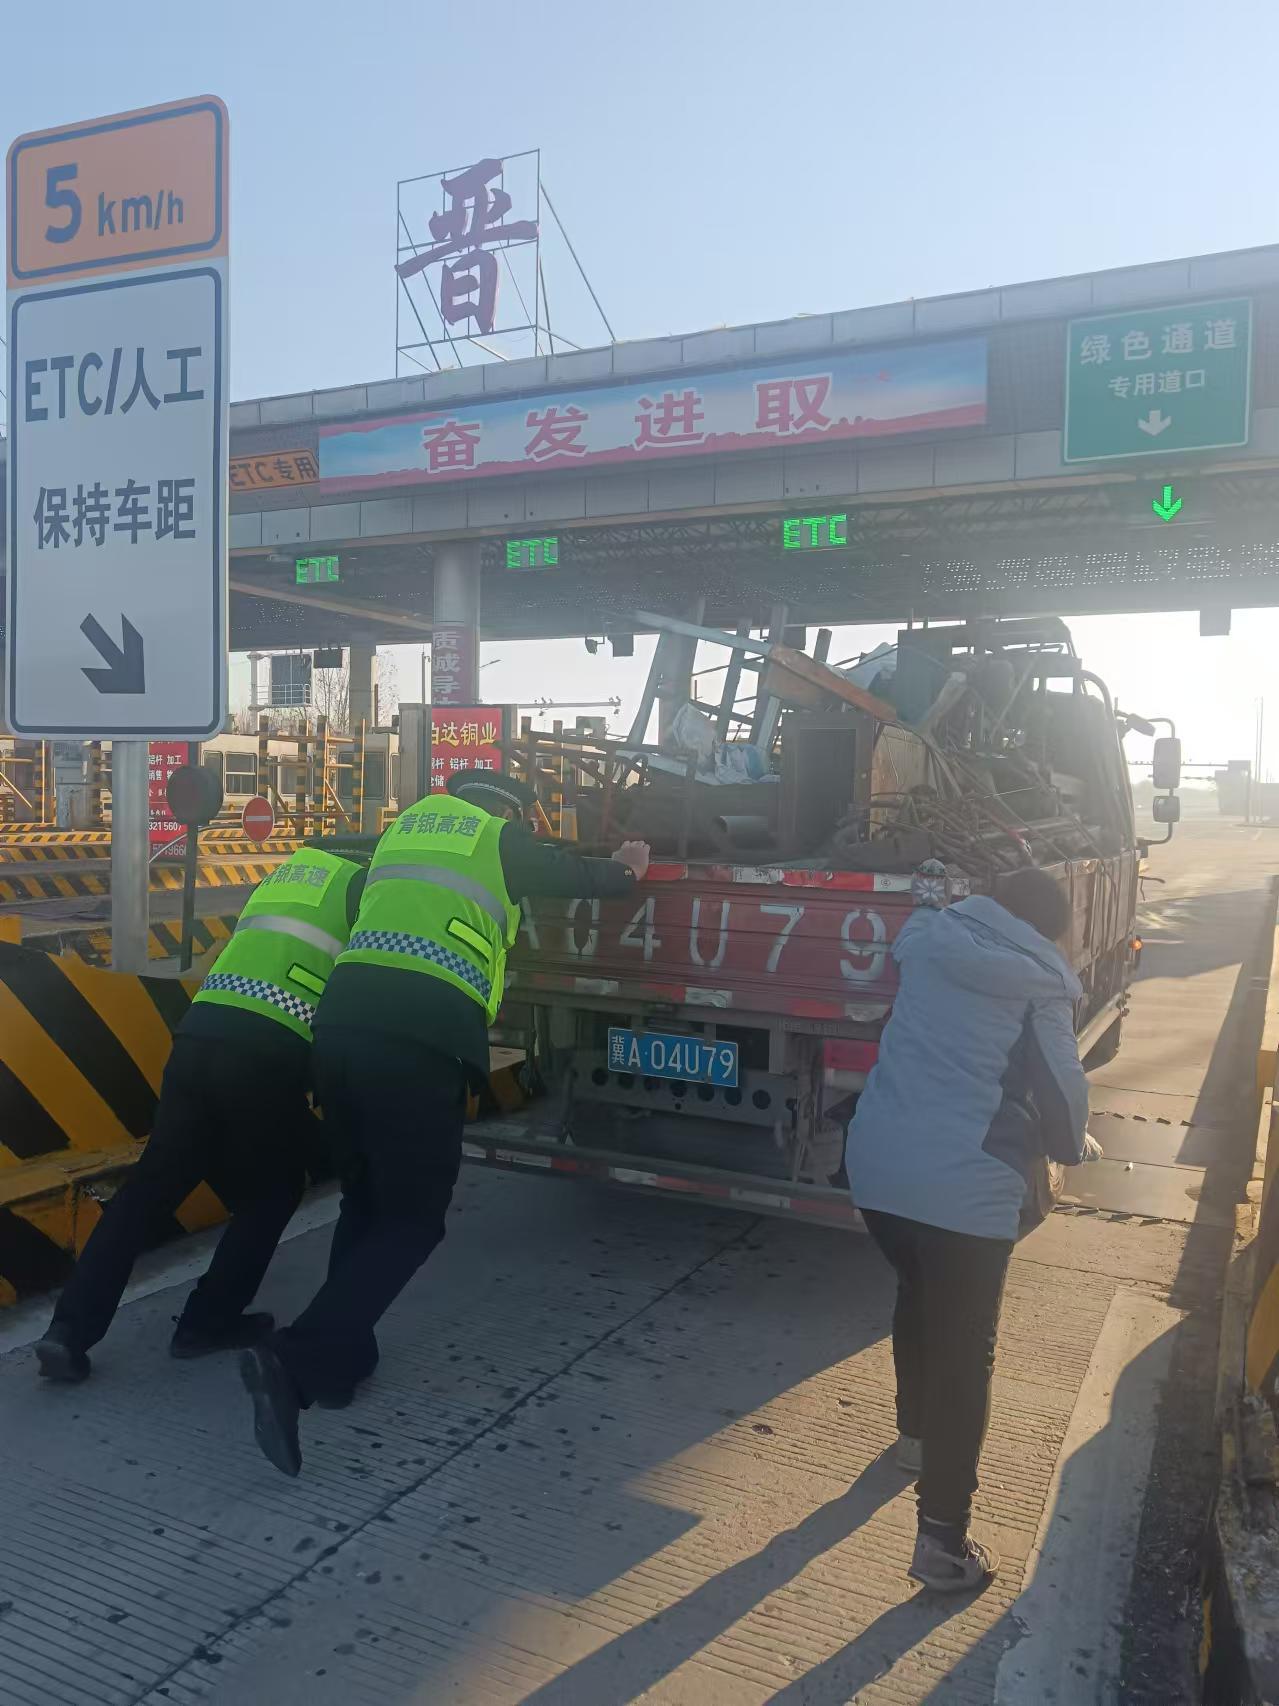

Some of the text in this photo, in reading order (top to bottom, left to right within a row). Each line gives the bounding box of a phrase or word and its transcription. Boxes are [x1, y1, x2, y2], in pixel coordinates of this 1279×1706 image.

[45, 163, 184, 243] 5 km/h
[394, 158, 539, 335] 晋
[1080, 319, 1238, 366] 绿色通道
[25, 347, 204, 422] ETC/人工
[1108, 370, 1206, 399] 专用道口
[423, 373, 832, 472] 奋发进取
[33, 478, 196, 549] 保持车距
[783, 514, 848, 549] ETC
[295, 556, 340, 585] ETC
[506, 537, 558, 568] ETC
[449, 757, 469, 770] 铝杆
[475, 757, 494, 770] 加工
[397, 812, 481, 837] 青银高速
